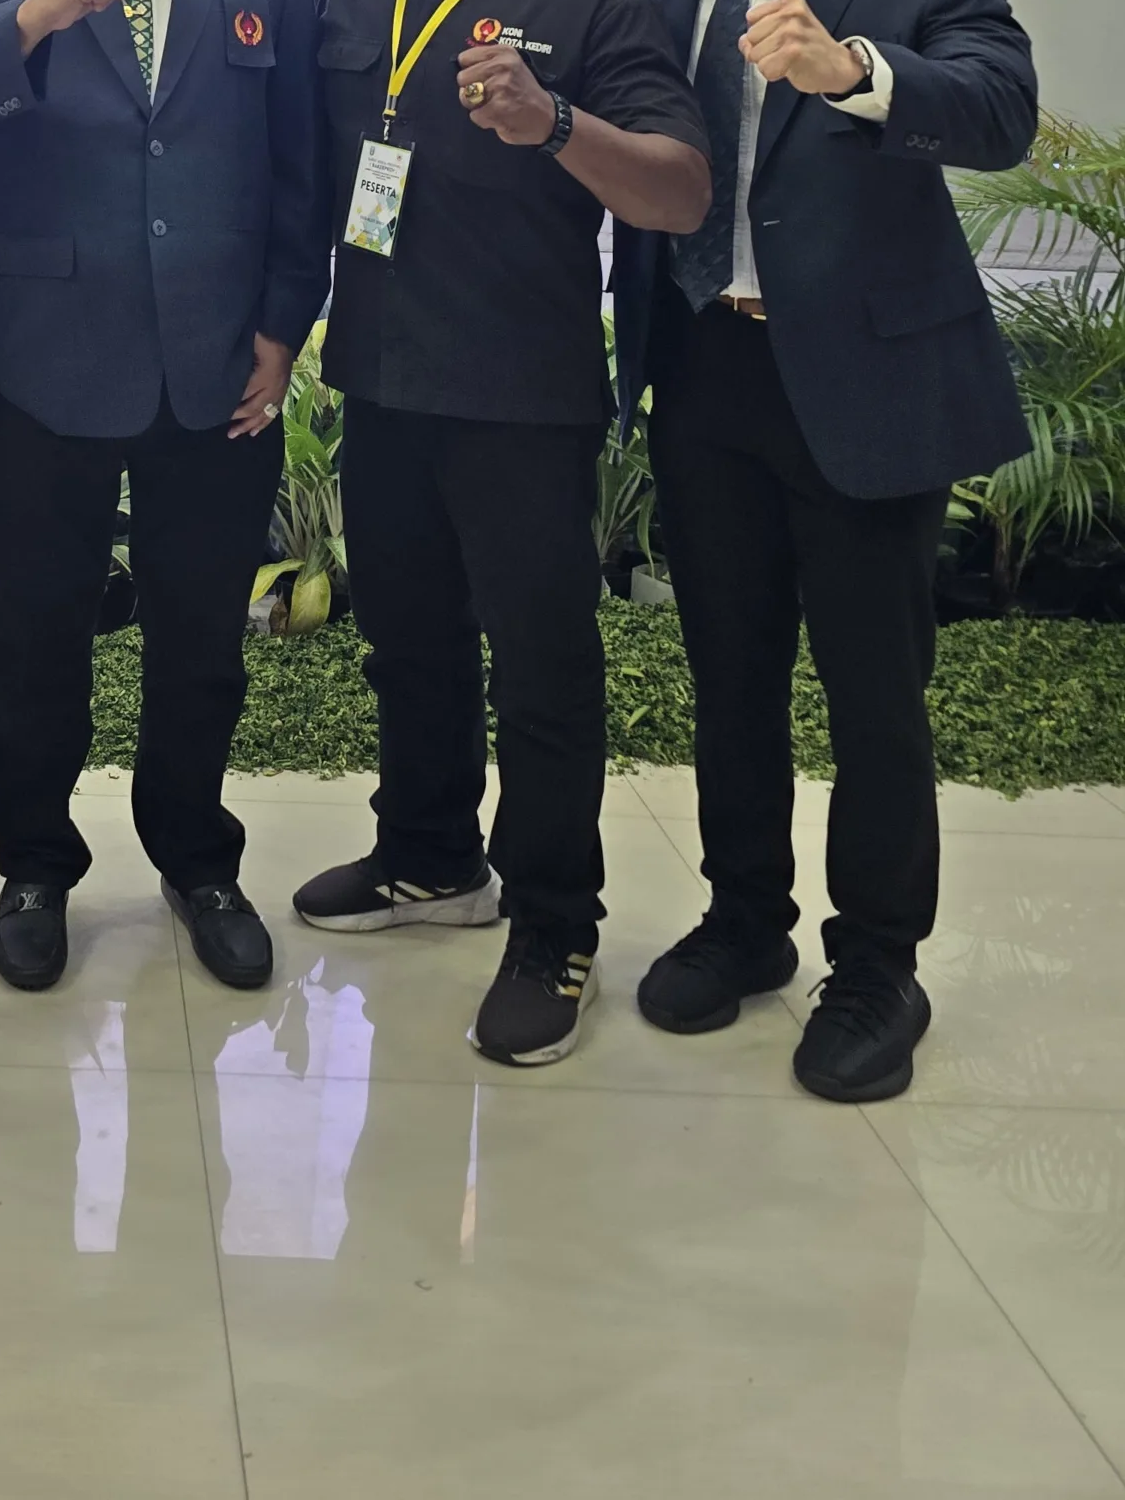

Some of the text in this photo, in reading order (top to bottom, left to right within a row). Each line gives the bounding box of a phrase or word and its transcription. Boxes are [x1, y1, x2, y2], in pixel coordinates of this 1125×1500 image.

[501, 26, 524, 38] KONI
[498, 36, 553, 55] KOTA KEDIRI
[360, 179, 397, 199] PESERTA
